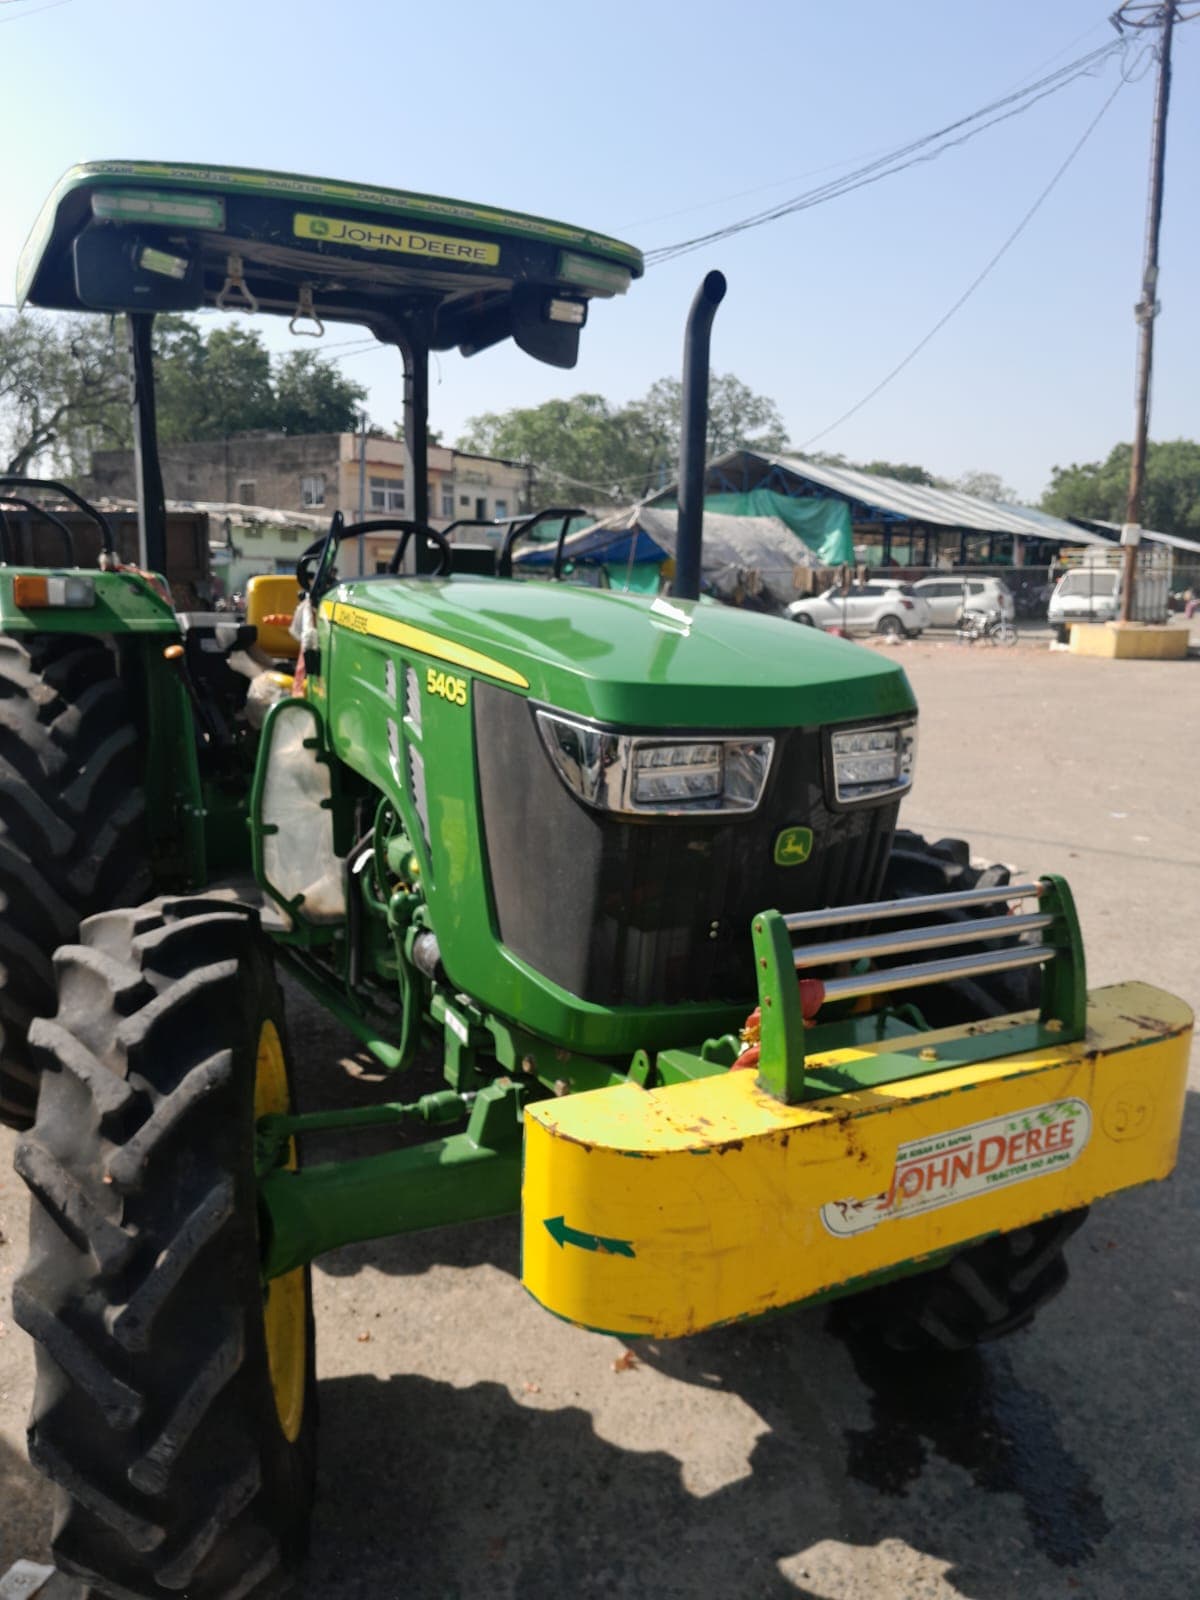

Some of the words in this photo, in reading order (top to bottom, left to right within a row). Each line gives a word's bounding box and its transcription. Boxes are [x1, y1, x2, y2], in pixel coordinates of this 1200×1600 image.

[333, 224, 403, 247] JOHN
[408, 234, 487, 260] DEERE
[427, 667, 467, 706] 5405
